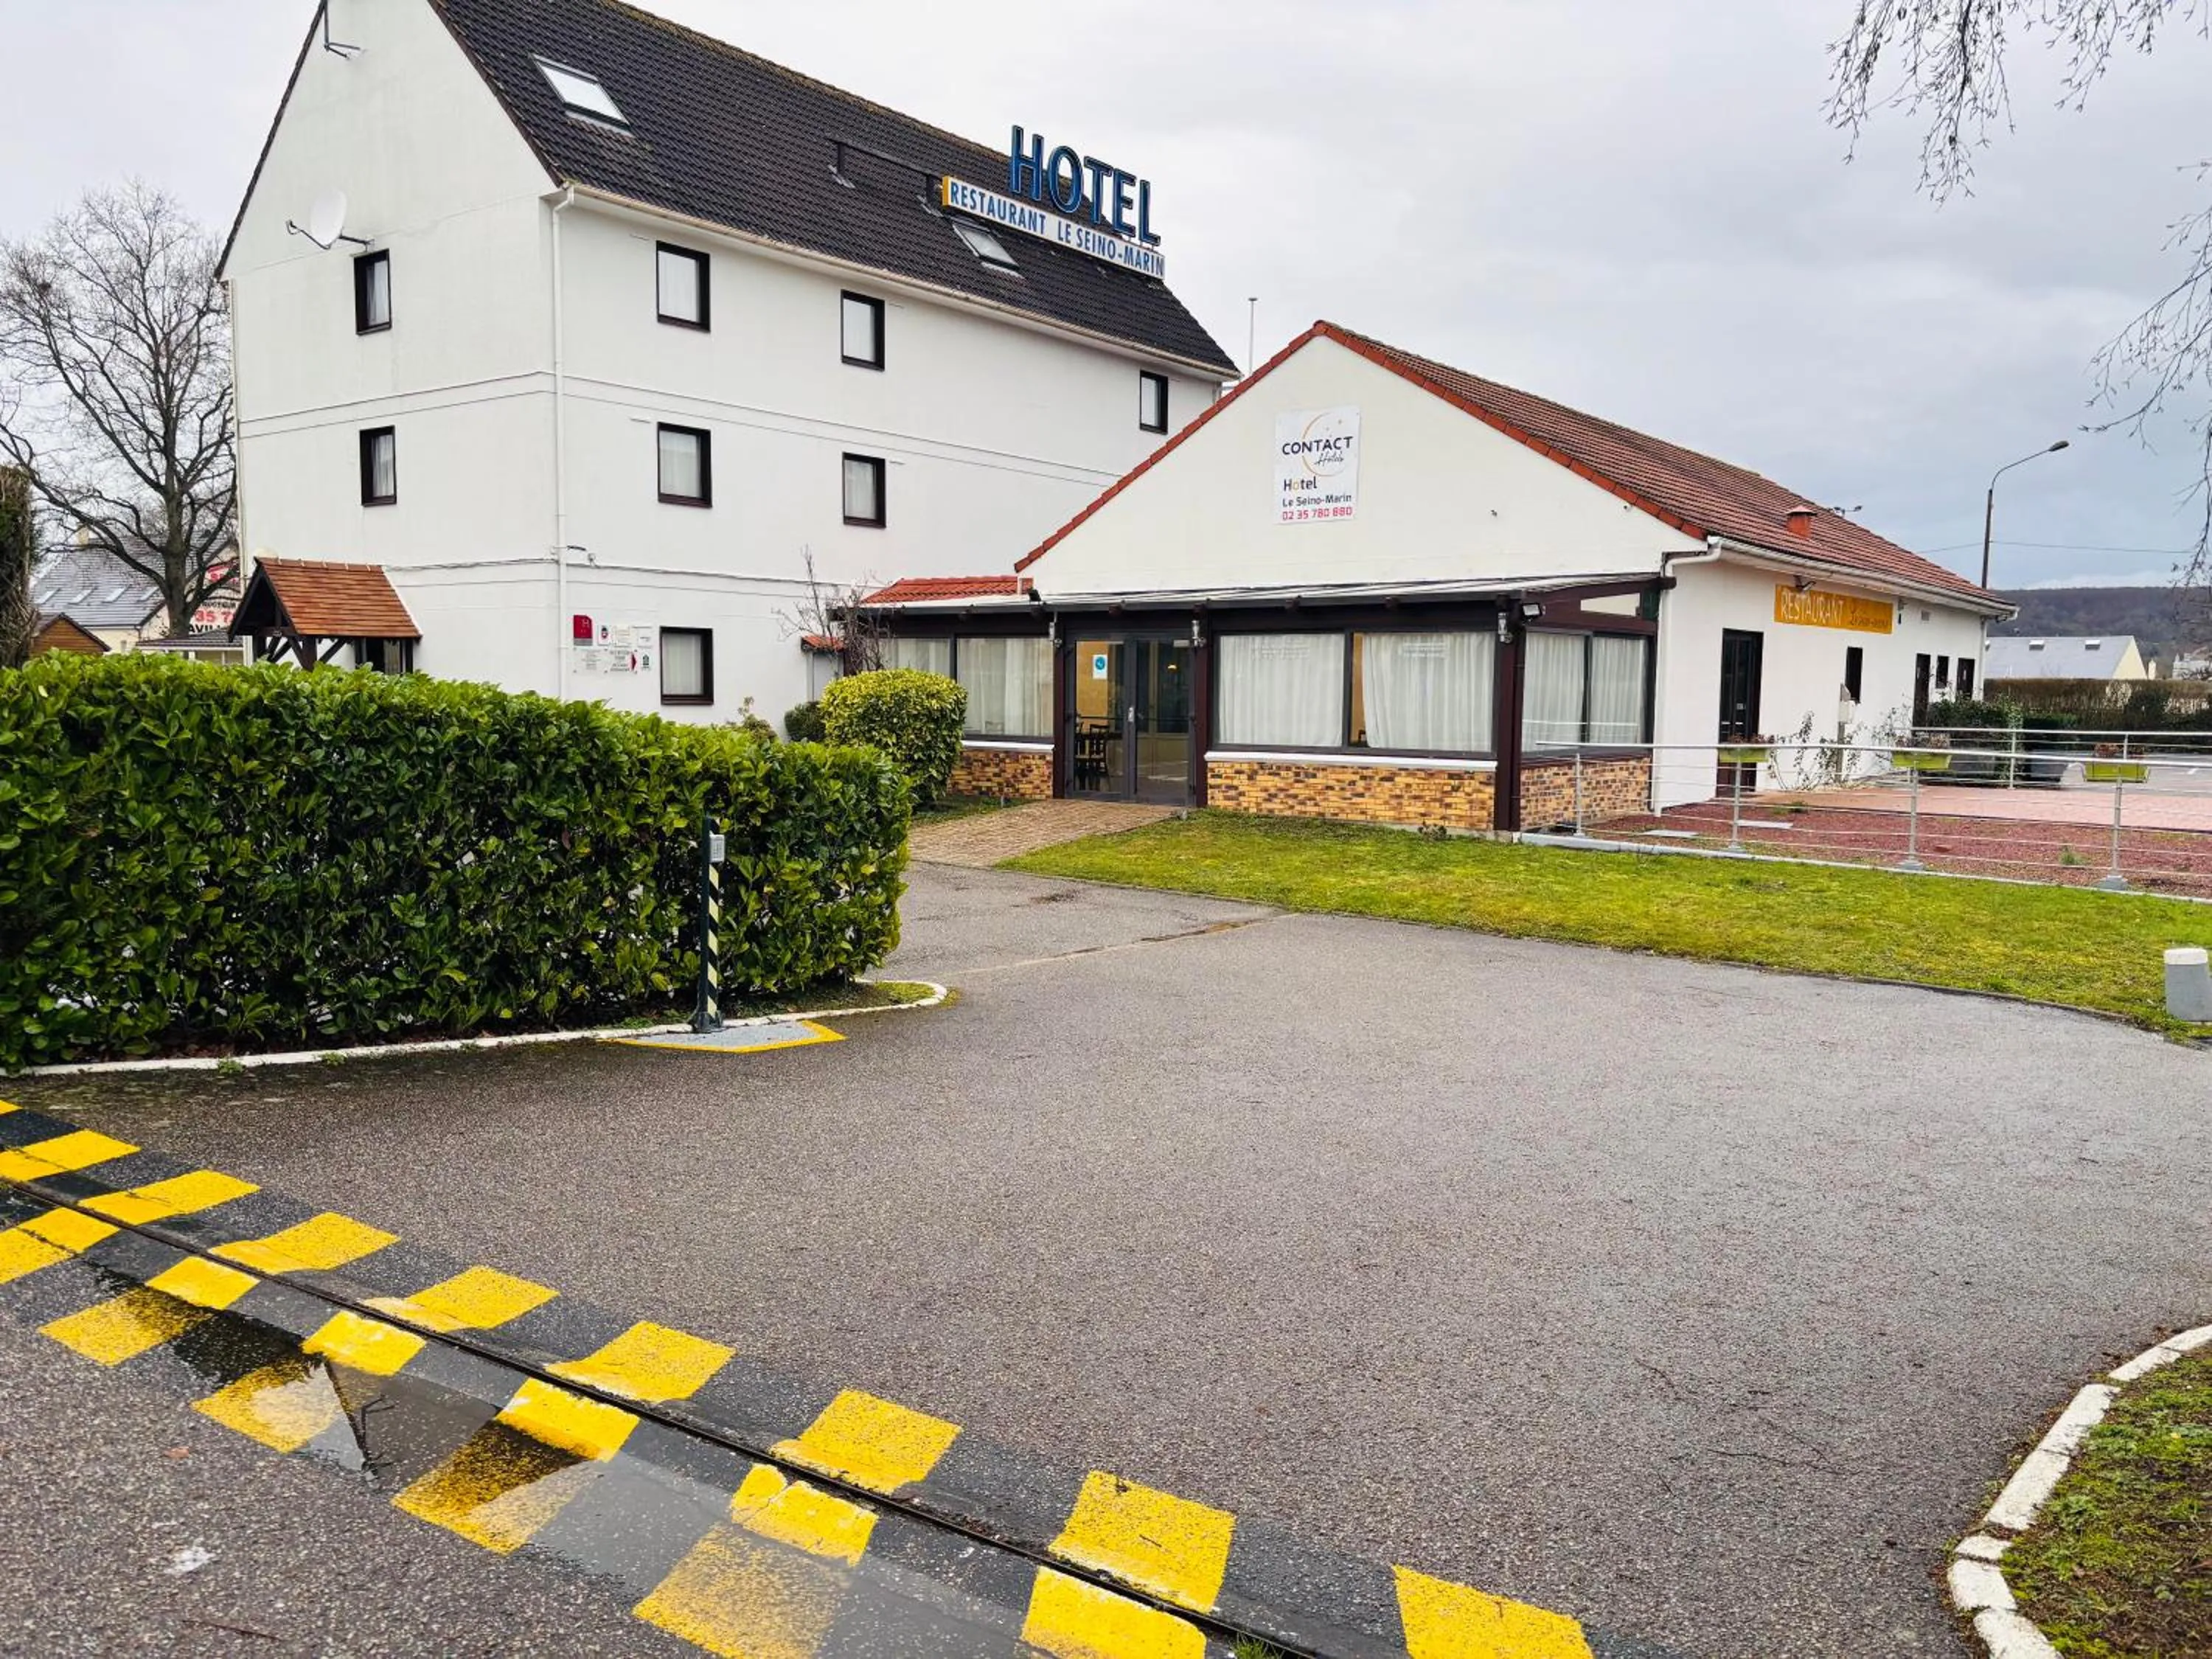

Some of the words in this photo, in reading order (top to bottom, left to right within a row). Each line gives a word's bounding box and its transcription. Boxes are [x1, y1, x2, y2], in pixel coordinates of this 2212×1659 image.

[1010, 125, 1161, 247] HOTEL
[950, 181, 1046, 235] RESTAURANT
[1057, 220, 1071, 243] LE
[1076, 228, 1164, 276] SEINO-MARIN
[1281, 436, 1354, 456] CONTACT
[1283, 476, 1318, 492] Hotel
[1282, 498, 1294, 507] Le
[1296, 494, 1352, 507] Seino-Marin
[1282, 510, 1294, 521] 02
[1297, 509, 1309, 520] 35
[1781, 590, 1844, 625] RESTAURANT
